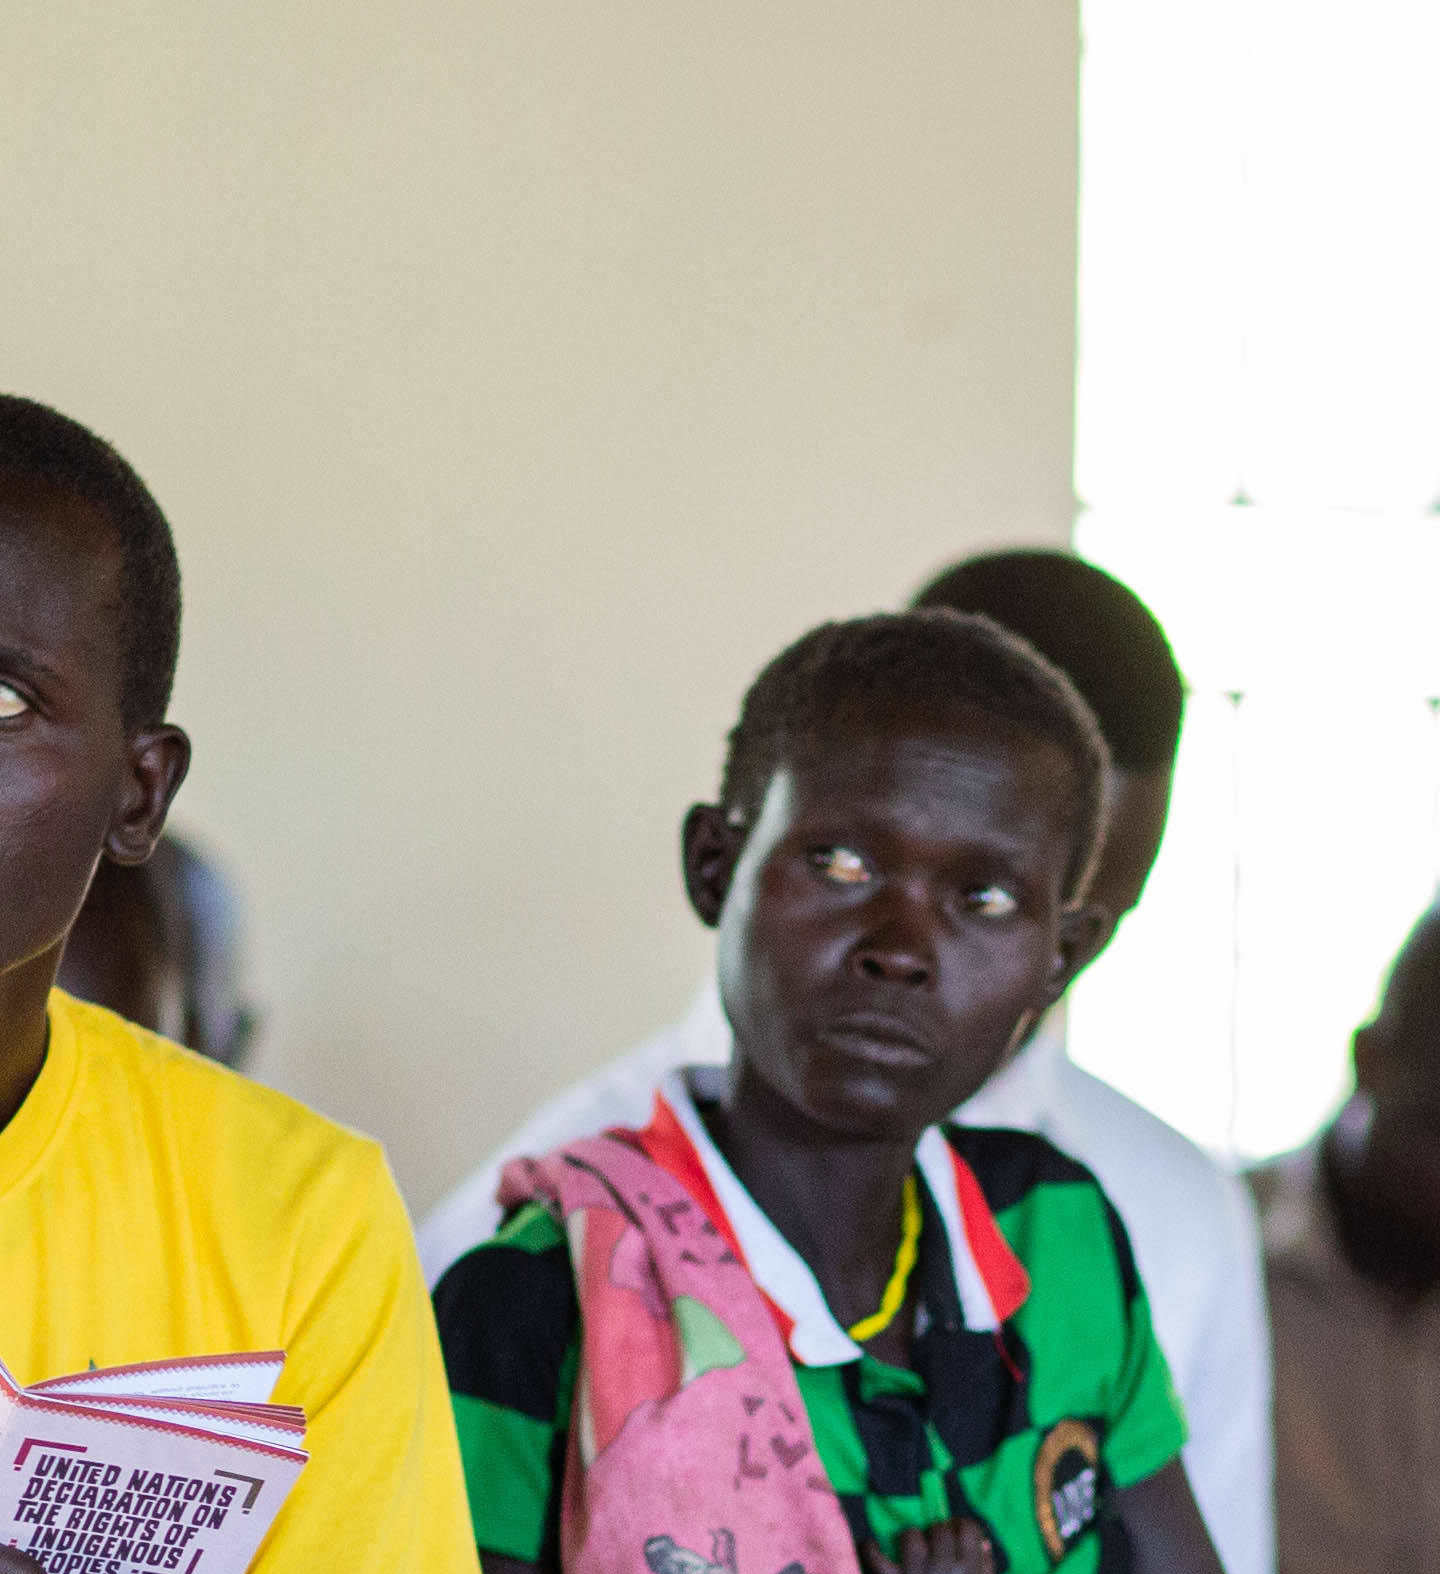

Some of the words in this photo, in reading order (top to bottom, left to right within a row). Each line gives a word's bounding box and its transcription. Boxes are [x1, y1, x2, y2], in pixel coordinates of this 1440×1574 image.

[22, 1477, 187, 1522] DECLARATION
[192, 1505, 228, 1529] ON
[34, 1454, 122, 1486] UNITED
[127, 1469, 237, 1507] NATIONS
[13, 1500, 62, 1525] THE
[65, 1507, 160, 1541] RIGHTS
[164, 1524, 199, 1548] OF
[28, 1526, 184, 1569] INDIGENOUS
